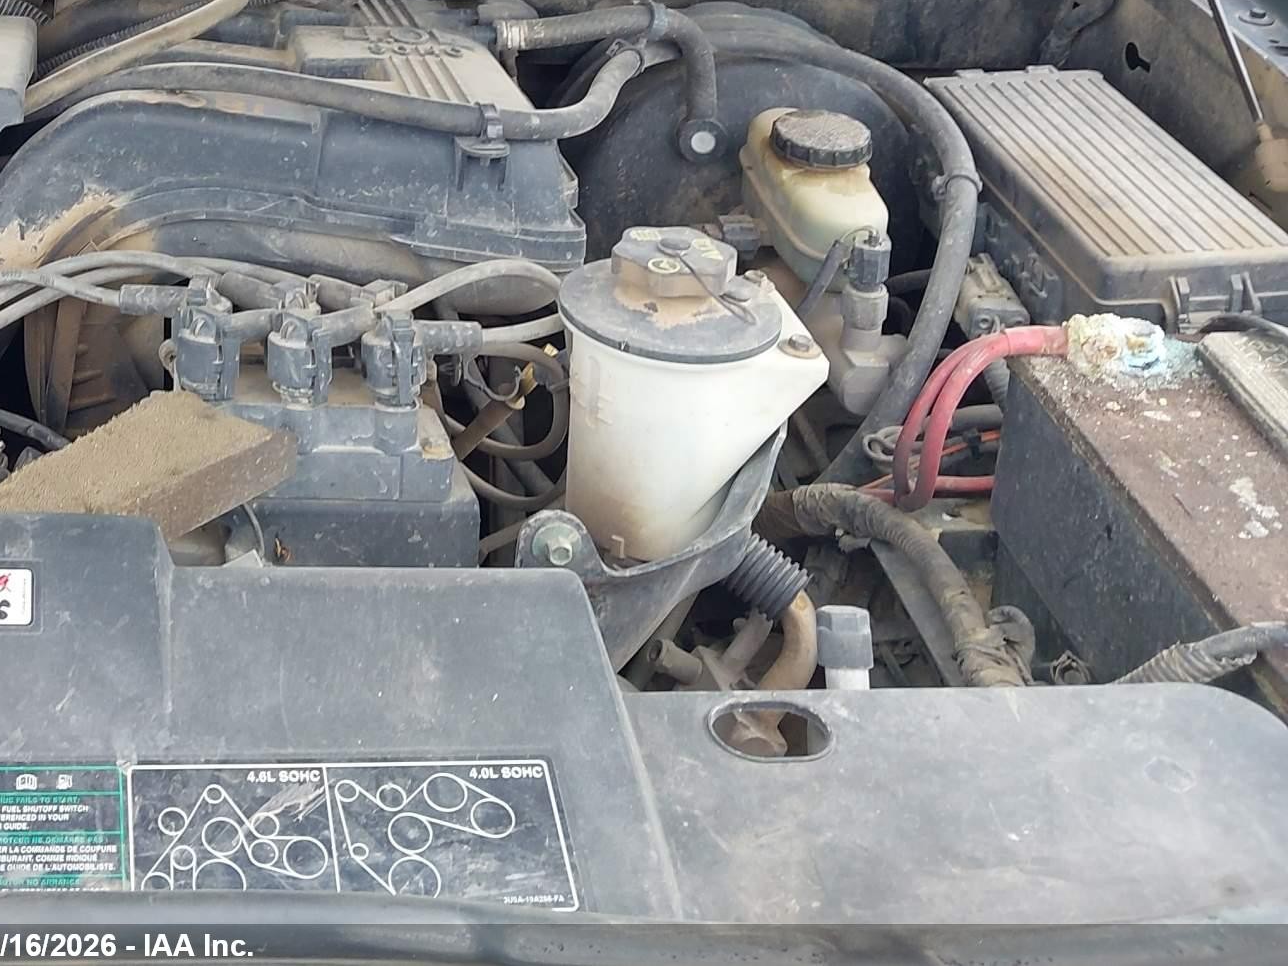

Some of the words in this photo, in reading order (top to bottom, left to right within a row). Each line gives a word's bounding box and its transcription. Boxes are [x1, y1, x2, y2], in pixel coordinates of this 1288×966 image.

[247, 770, 275, 783] 4.6L
[279, 770, 320, 783] SOHC
[470, 766, 499, 779] 4.0L
[501, 766, 543, 779] SOHC
[2, 805, 21, 813] FUEL
[23, 805, 58, 813] SHUTOFF
[59, 805, 89, 813] SWITCH
[3, 822, 30, 830] GUIDE.
[9, 844, 19, 853] LA
[20, 844, 65, 853] COMMANDE
[67, 844, 78, 853] DE
[79, 844, 117, 853] COUPURE
[35, 854, 64, 862] COMME
[6, 863, 31, 871] GUIDE
[32, 863, 43, 871] DE
